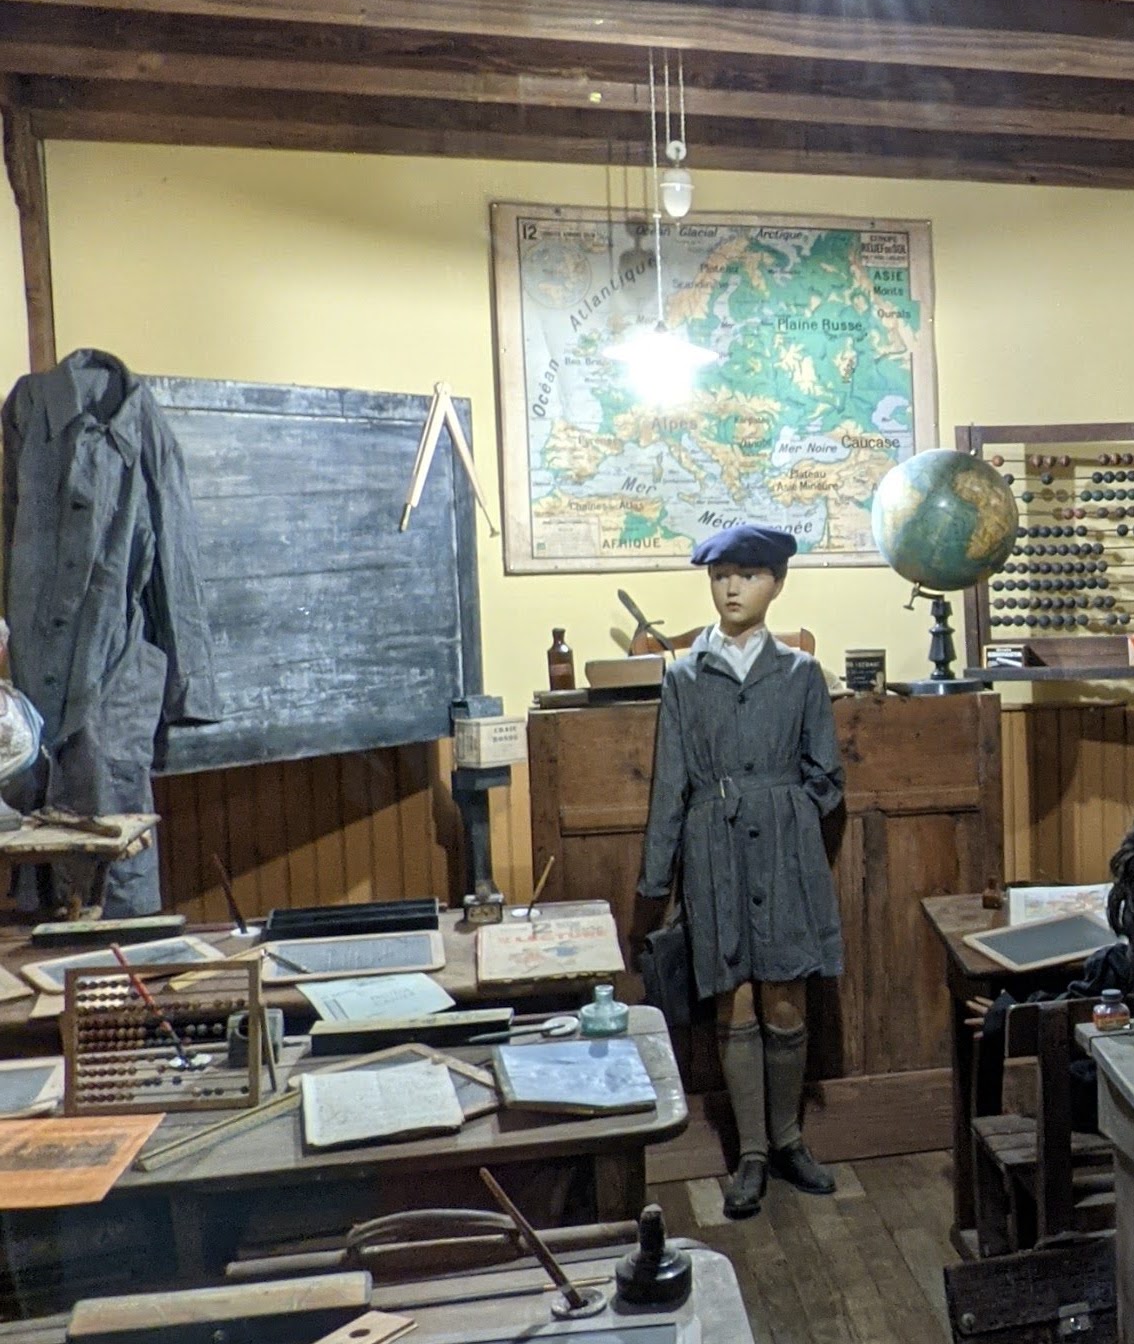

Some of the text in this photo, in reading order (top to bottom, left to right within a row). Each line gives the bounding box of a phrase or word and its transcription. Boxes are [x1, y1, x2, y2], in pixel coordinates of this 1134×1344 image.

[522, 224, 537, 240] 12
[679, 226, 718, 238] Glacial
[756, 228, 803, 241] Arctique
[874, 270, 905, 282] ASIE
[569, 255, 658, 332] Atlantique
[873, 286, 905, 296] Monts
[777, 318, 863, 332] Plaine Russe
[532, 358, 560, 419] Océan
[651, 417, 699, 433] Alpes
[778, 442, 838, 454] Mer Noire
[841, 434, 901, 449] Caucase
[621, 476, 657, 496] Mer
[602, 537, 662, 550] AFRIQUE
